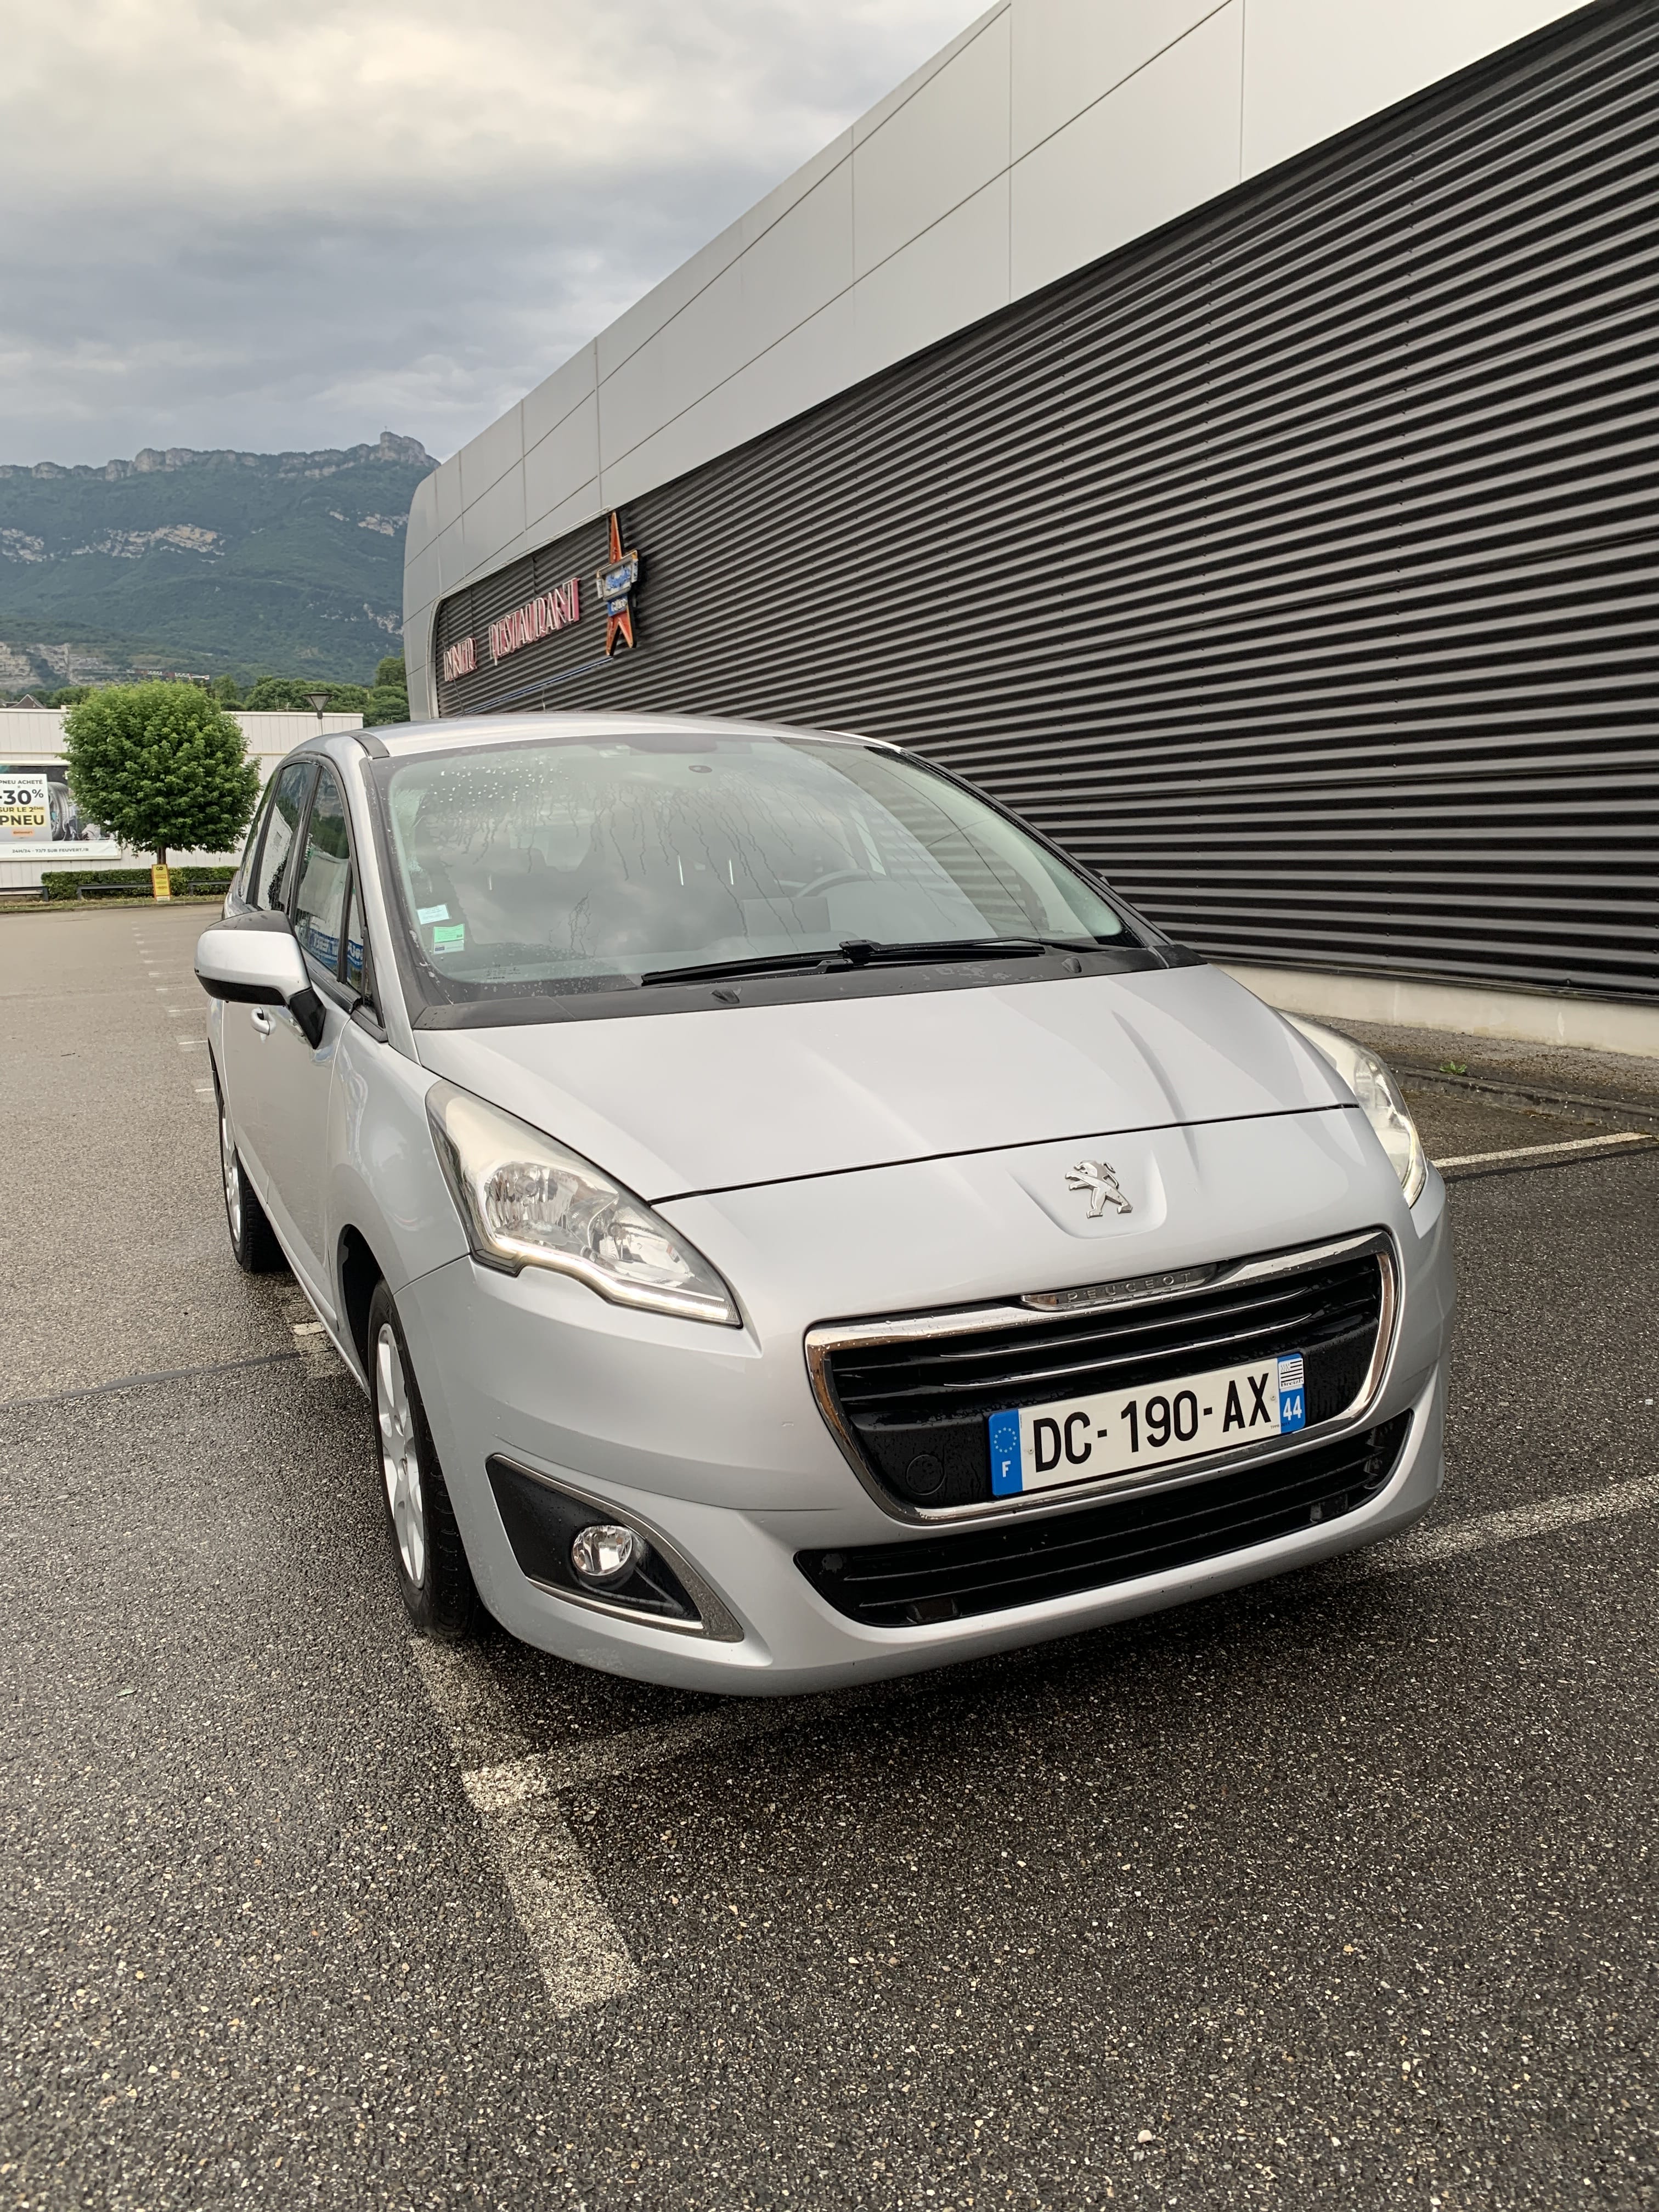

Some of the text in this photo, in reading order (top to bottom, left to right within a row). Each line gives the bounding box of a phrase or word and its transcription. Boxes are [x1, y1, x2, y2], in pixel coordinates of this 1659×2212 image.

[488, 577, 582, 666] RESTAURANT
[0, 815, 44, 825] PNEU
[1067, 1272, 1190, 1302] PEUGEOT
[1280, 1379, 1304, 1387] Breizh
[1283, 1395, 1302, 1421] 44
[1002, 1460, 1011, 1478] F
